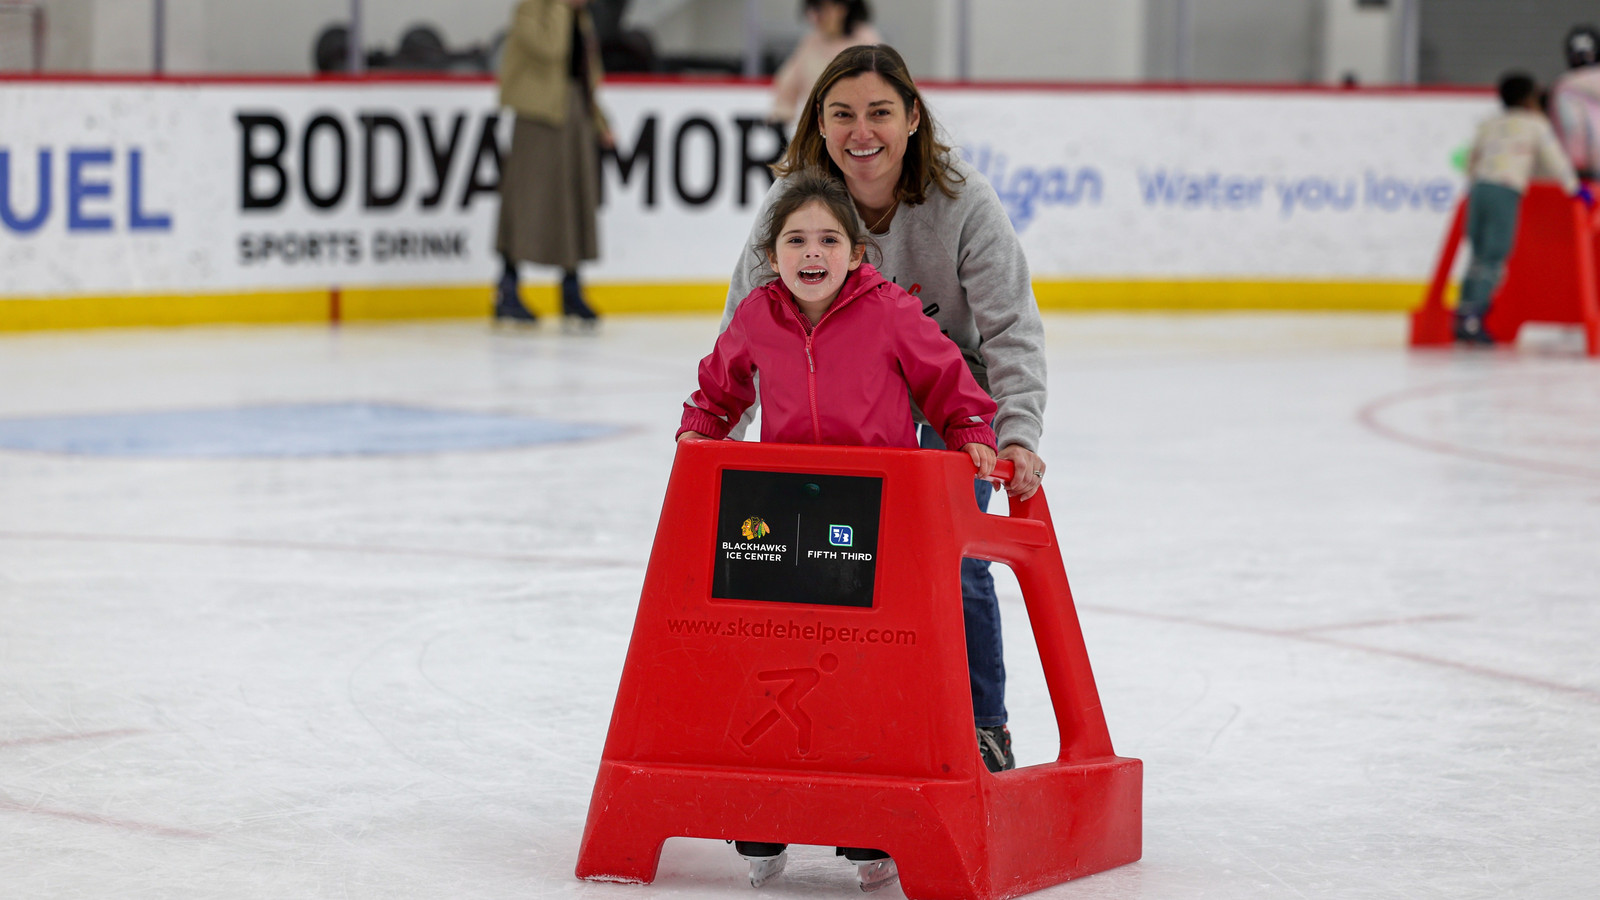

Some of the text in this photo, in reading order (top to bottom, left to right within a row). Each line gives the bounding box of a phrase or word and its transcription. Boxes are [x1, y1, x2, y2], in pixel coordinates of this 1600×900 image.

[0, 147, 172, 233] UEL
[1138, 167, 1456, 221] Water you love
[238, 229, 470, 267] SPORTS DRINK
[722, 541, 787, 553] BLACKHAWKS
[726, 551, 782, 562] ICE CENTER
[807, 550, 873, 562] FIFTH THIRD
[667, 617, 917, 646] www.skatehelper.com
